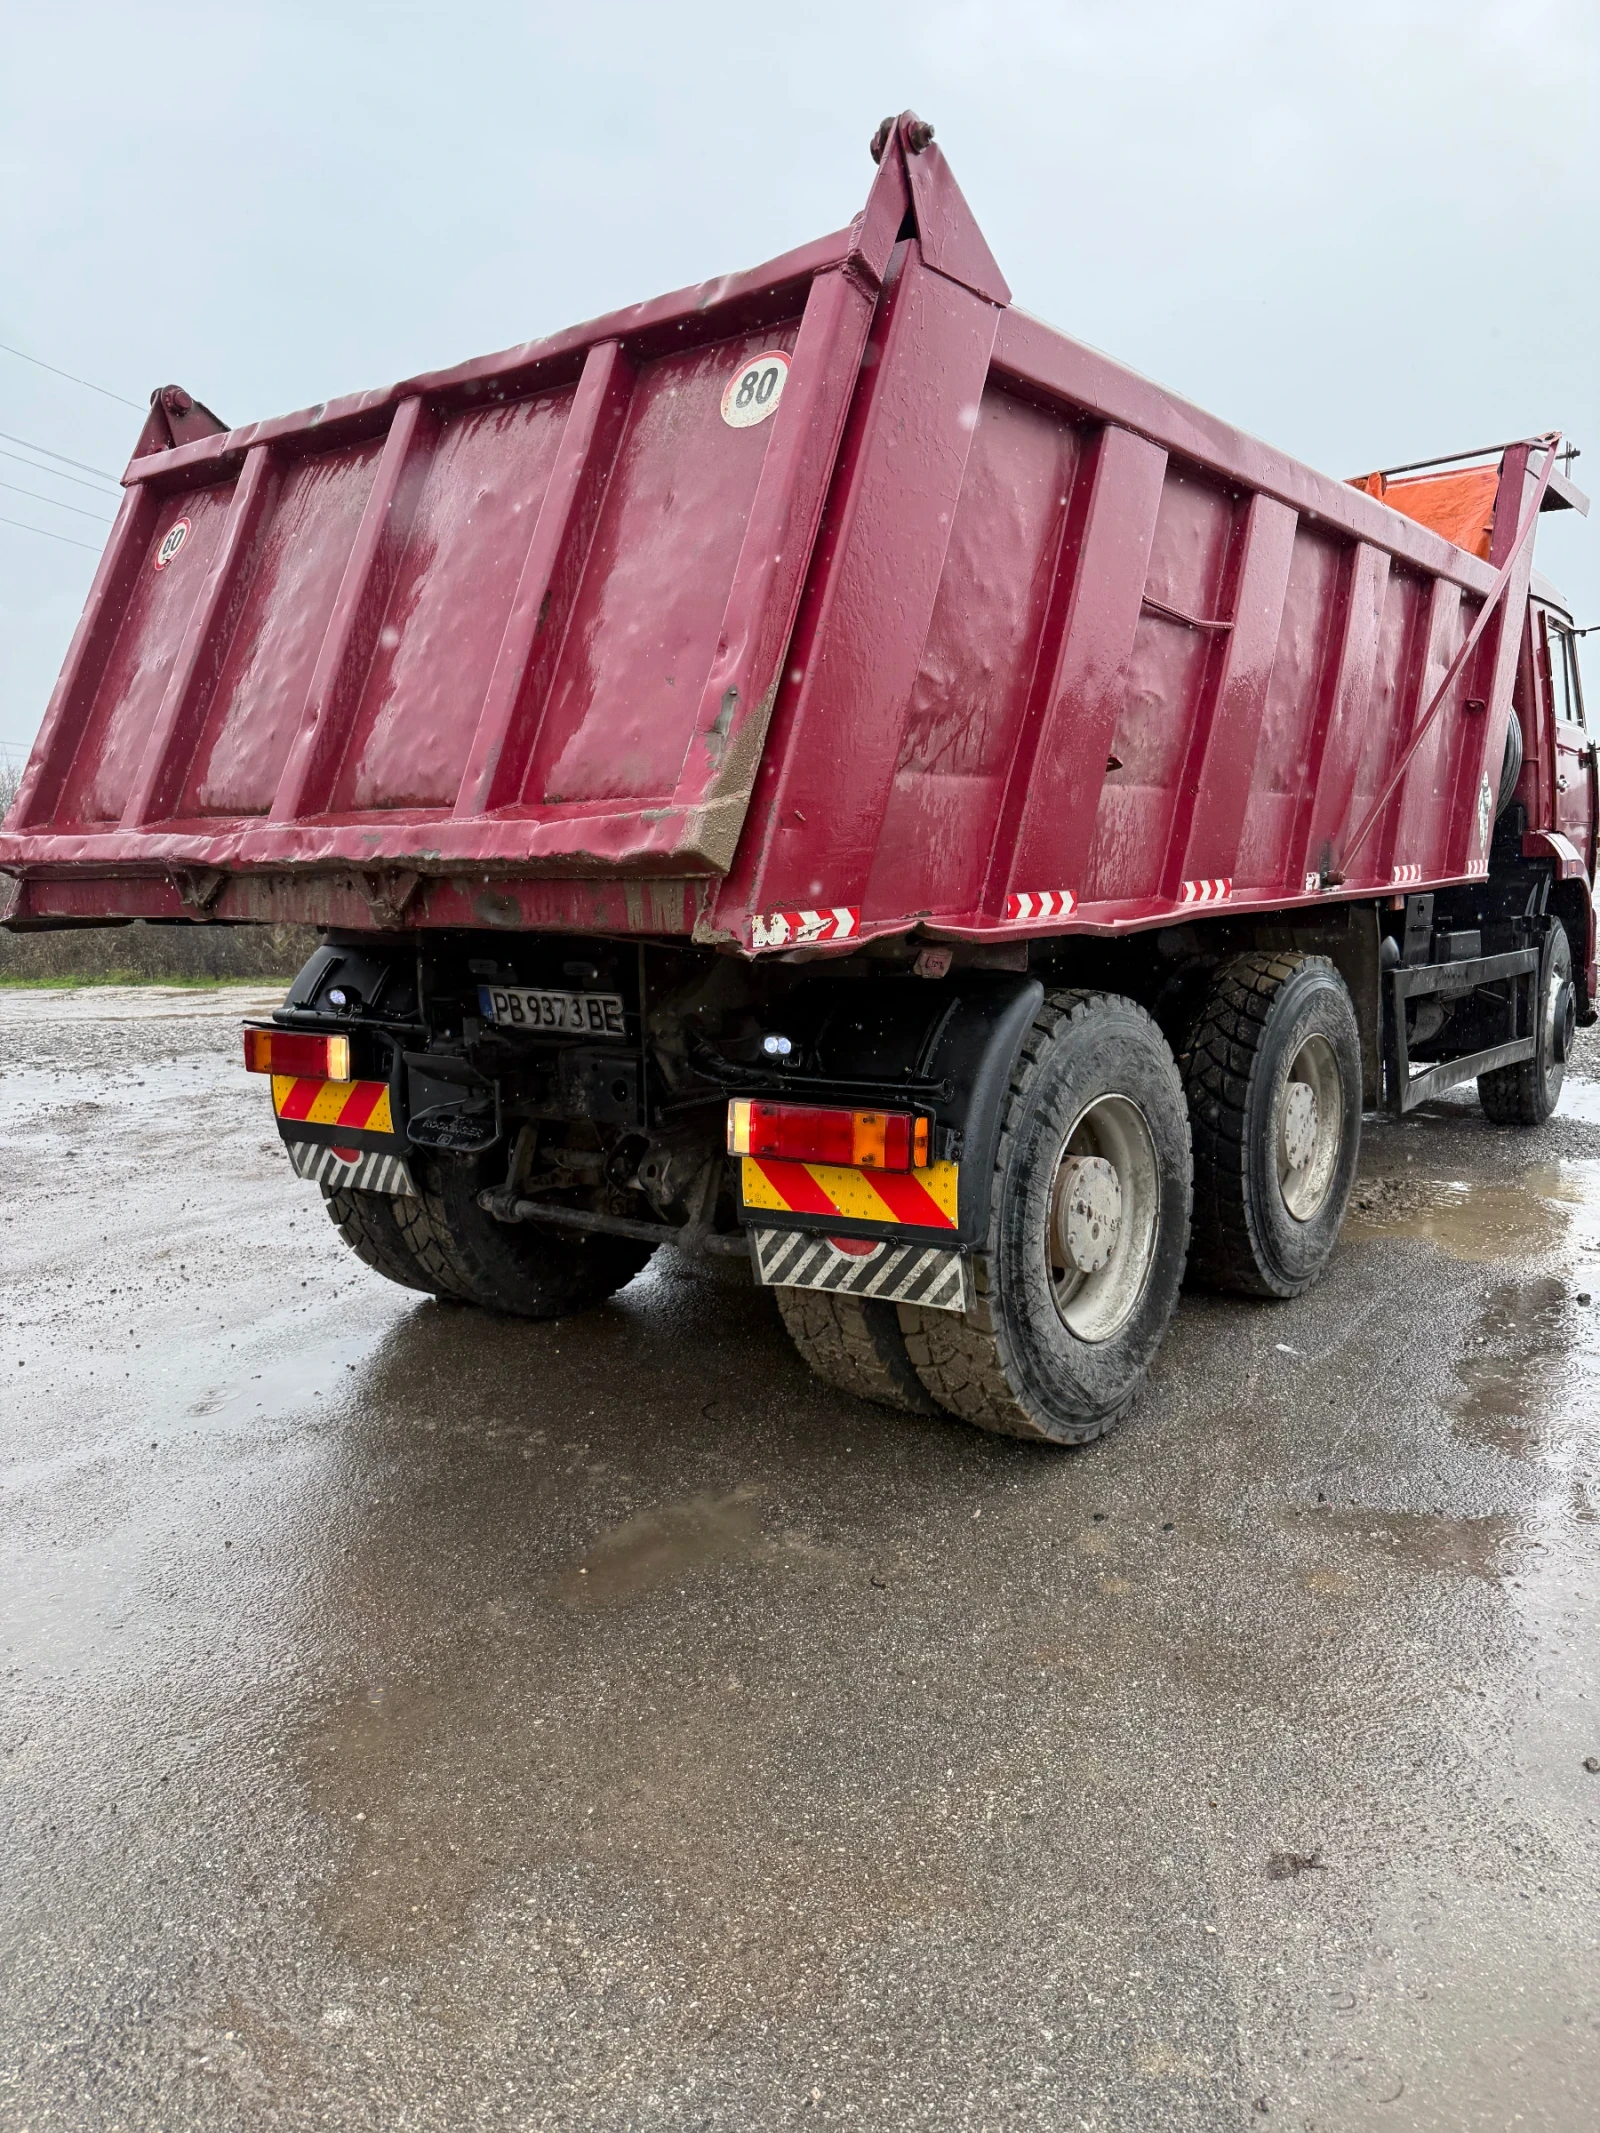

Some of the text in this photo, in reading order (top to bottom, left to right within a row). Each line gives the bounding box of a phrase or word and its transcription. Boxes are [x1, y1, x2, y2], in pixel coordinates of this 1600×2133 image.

[736, 367, 778, 408] 80
[162, 528, 185, 555] 60
[493, 992, 623, 1033] PB 9373 BE
